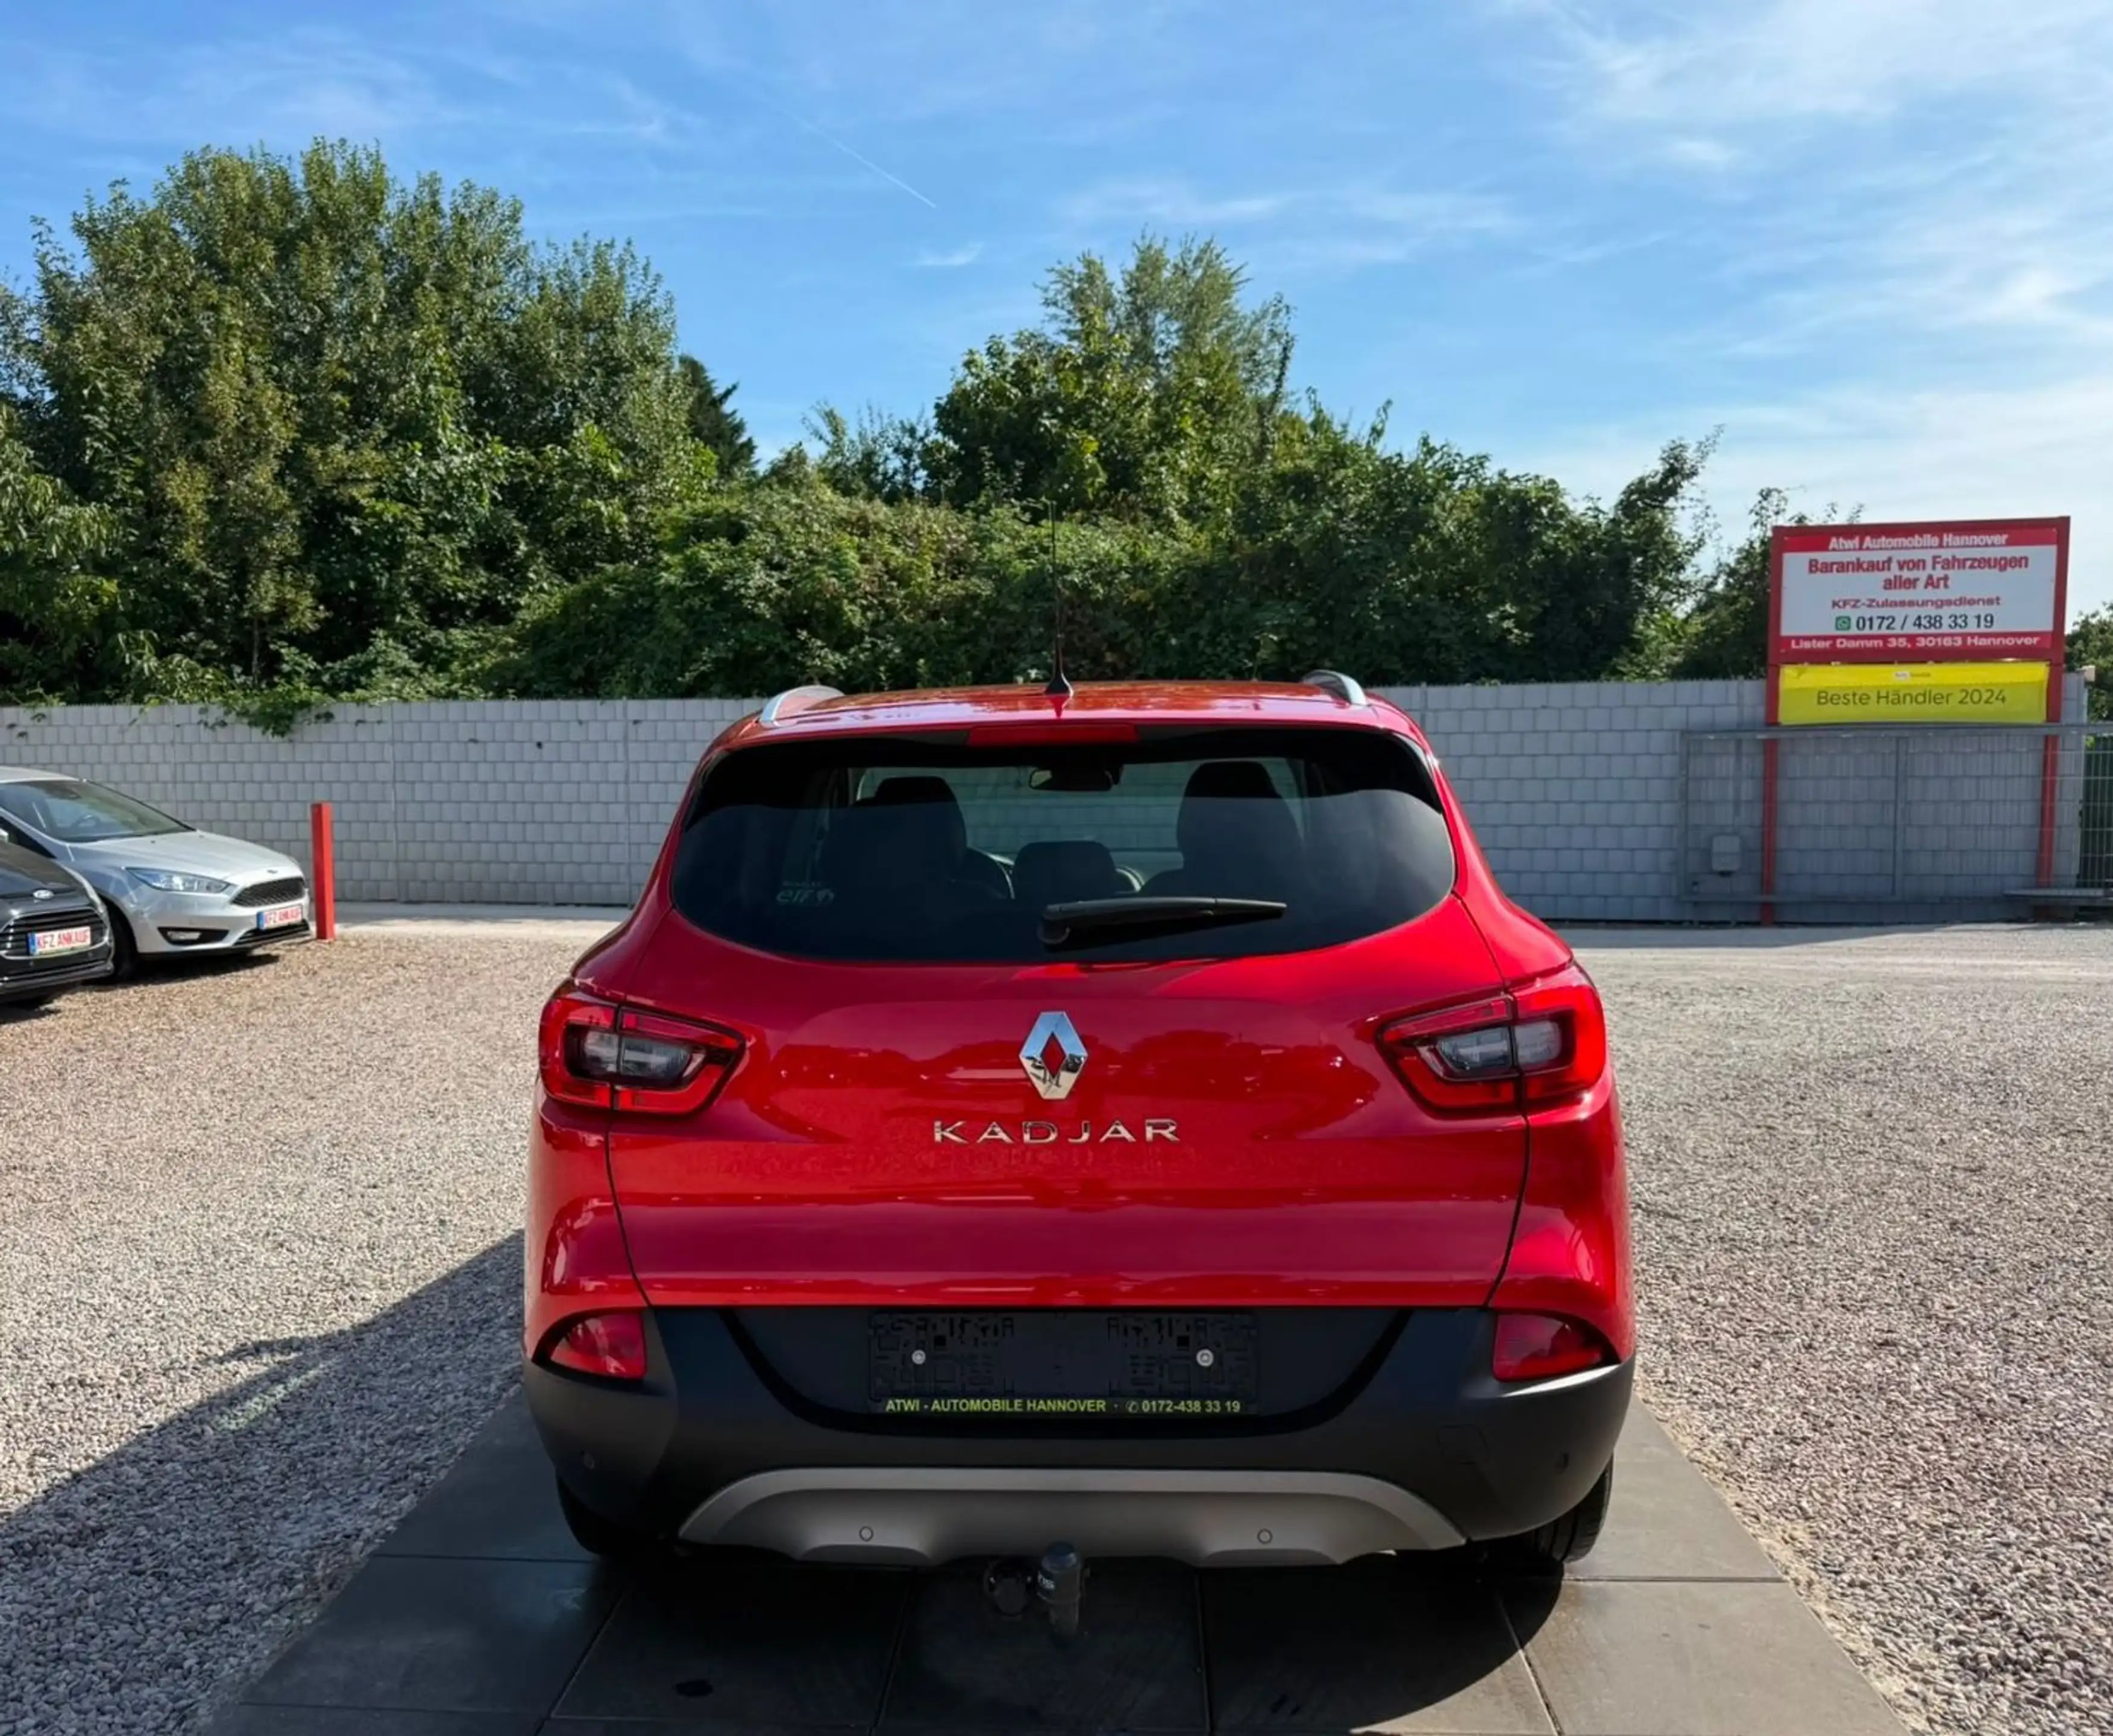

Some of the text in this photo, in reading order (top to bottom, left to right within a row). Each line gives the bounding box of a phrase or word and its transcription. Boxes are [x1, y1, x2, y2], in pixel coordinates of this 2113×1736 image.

[1862, 533, 1939, 549] Automobile
[1943, 533, 2009, 547] Hannover
[1809, 555, 2029, 574] Barankauf von Fahrzeugen
[1882, 573, 1950, 591] aller Art
[1831, 596, 2002, 609] KFZ-Zulassungsdienst
[1856, 615, 1896, 632] 0172
[1912, 614, 1943, 631] 438
[1948, 614, 1968, 629] 33
[1974, 613, 1994, 629] 19
[1791, 634, 2041, 650] Lister Damm 35, 30163 Hannover
[1816, 687, 2007, 706] Beste Händler 2024
[933, 1119, 1180, 1143] KADJAR
[885, 1399, 920, 1412] ATWI
[931, 1399, 1023, 1412] AUTOMOBILE
[1027, 1400, 1107, 1412] HANNOVER
[1141, 1400, 1241, 1413] 0172-438 33 19
